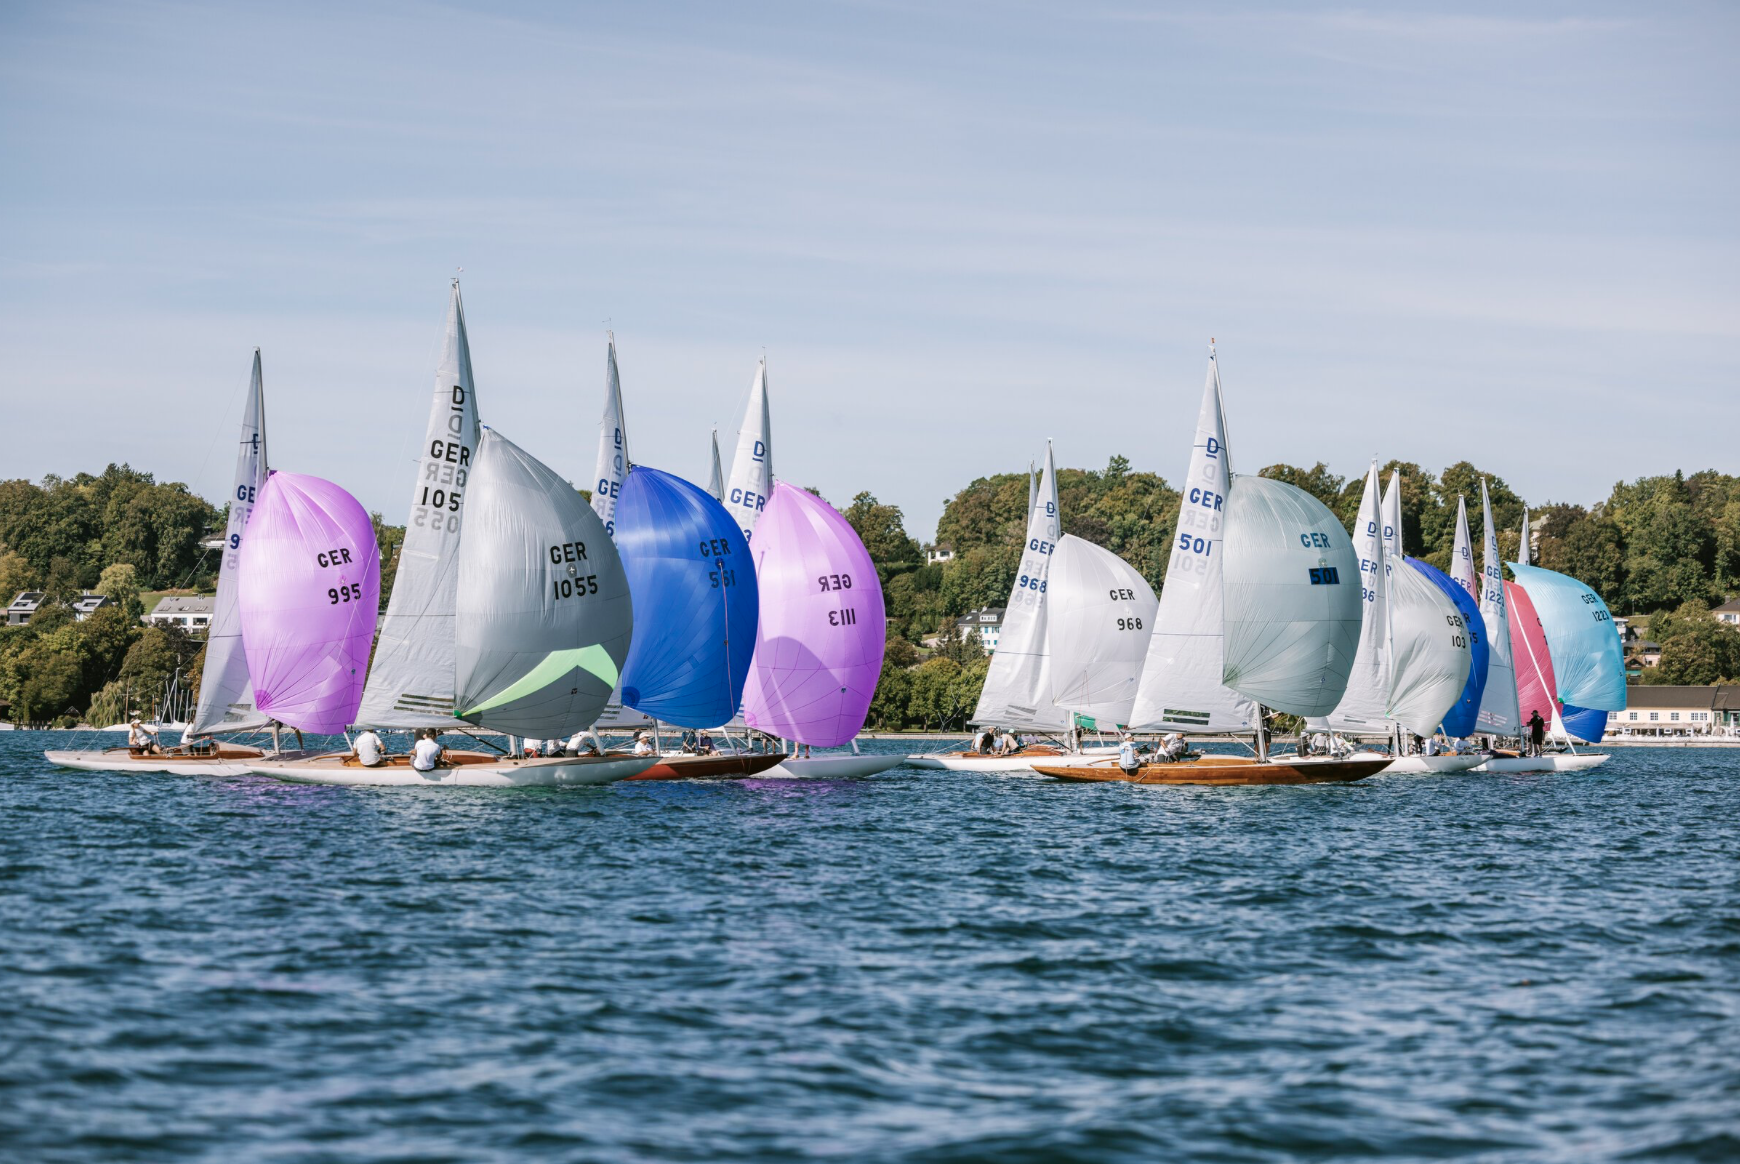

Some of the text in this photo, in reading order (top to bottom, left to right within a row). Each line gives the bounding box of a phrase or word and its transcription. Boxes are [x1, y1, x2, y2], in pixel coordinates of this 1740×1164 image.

[452, 386, 464, 405] D
[430, 440, 470, 467] GER
[753, 441, 765, 457] D
[1207, 437, 1218, 454] D
[237, 484, 256, 504] GE
[598, 479, 622, 499] GE
[421, 487, 462, 512] 105
[730, 488, 765, 512] GER
[1046, 501, 1055, 514] D
[1189, 488, 1223, 512] GER
[1368, 521, 1377, 534] D
[1384, 525, 1393, 537] D
[700, 538, 731, 557] GER
[1179, 533, 1212, 556] 501
[1301, 533, 1331, 548] GER
[317, 548, 352, 568] GER
[550, 542, 587, 564] GER
[1462, 546, 1468, 557] D
[1310, 568, 1338, 585] 501
[1360, 559, 1378, 575] ER
[554, 575, 598, 600] 1055
[709, 569, 736, 588] 561
[1020, 575, 1047, 593] 968
[328, 583, 361, 605] 995
[1110, 589, 1135, 601] GER
[1581, 593, 1598, 604] GER
[1117, 618, 1142, 631] 968
